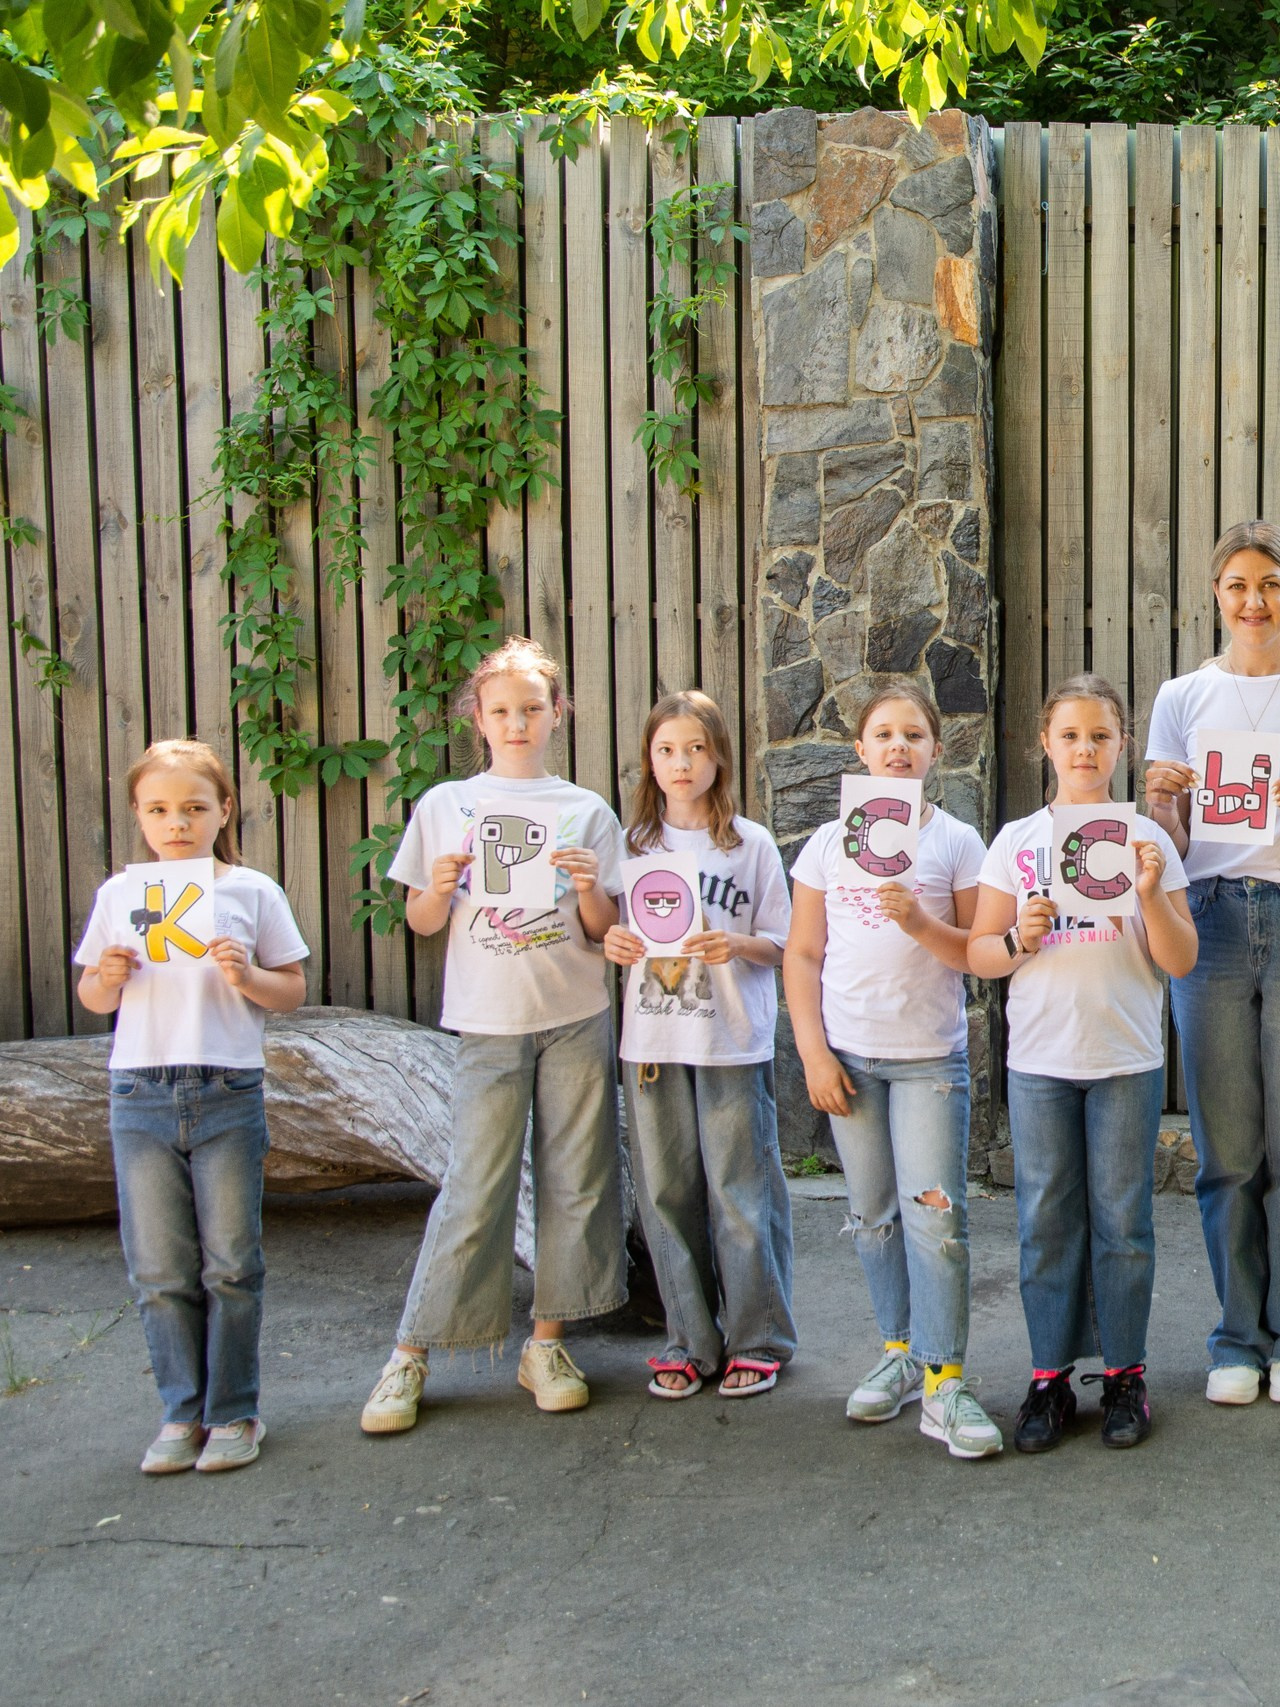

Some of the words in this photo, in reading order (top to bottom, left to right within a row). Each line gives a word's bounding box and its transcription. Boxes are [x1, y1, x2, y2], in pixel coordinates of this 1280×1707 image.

[1016, 846, 1053, 890] SU
[698, 871, 750, 918] ute
[141, 881, 209, 962] К
[1042, 931, 1072, 946] WAYS
[1080, 930, 1117, 943] SMILE
[694, 1007, 718, 1019] me
